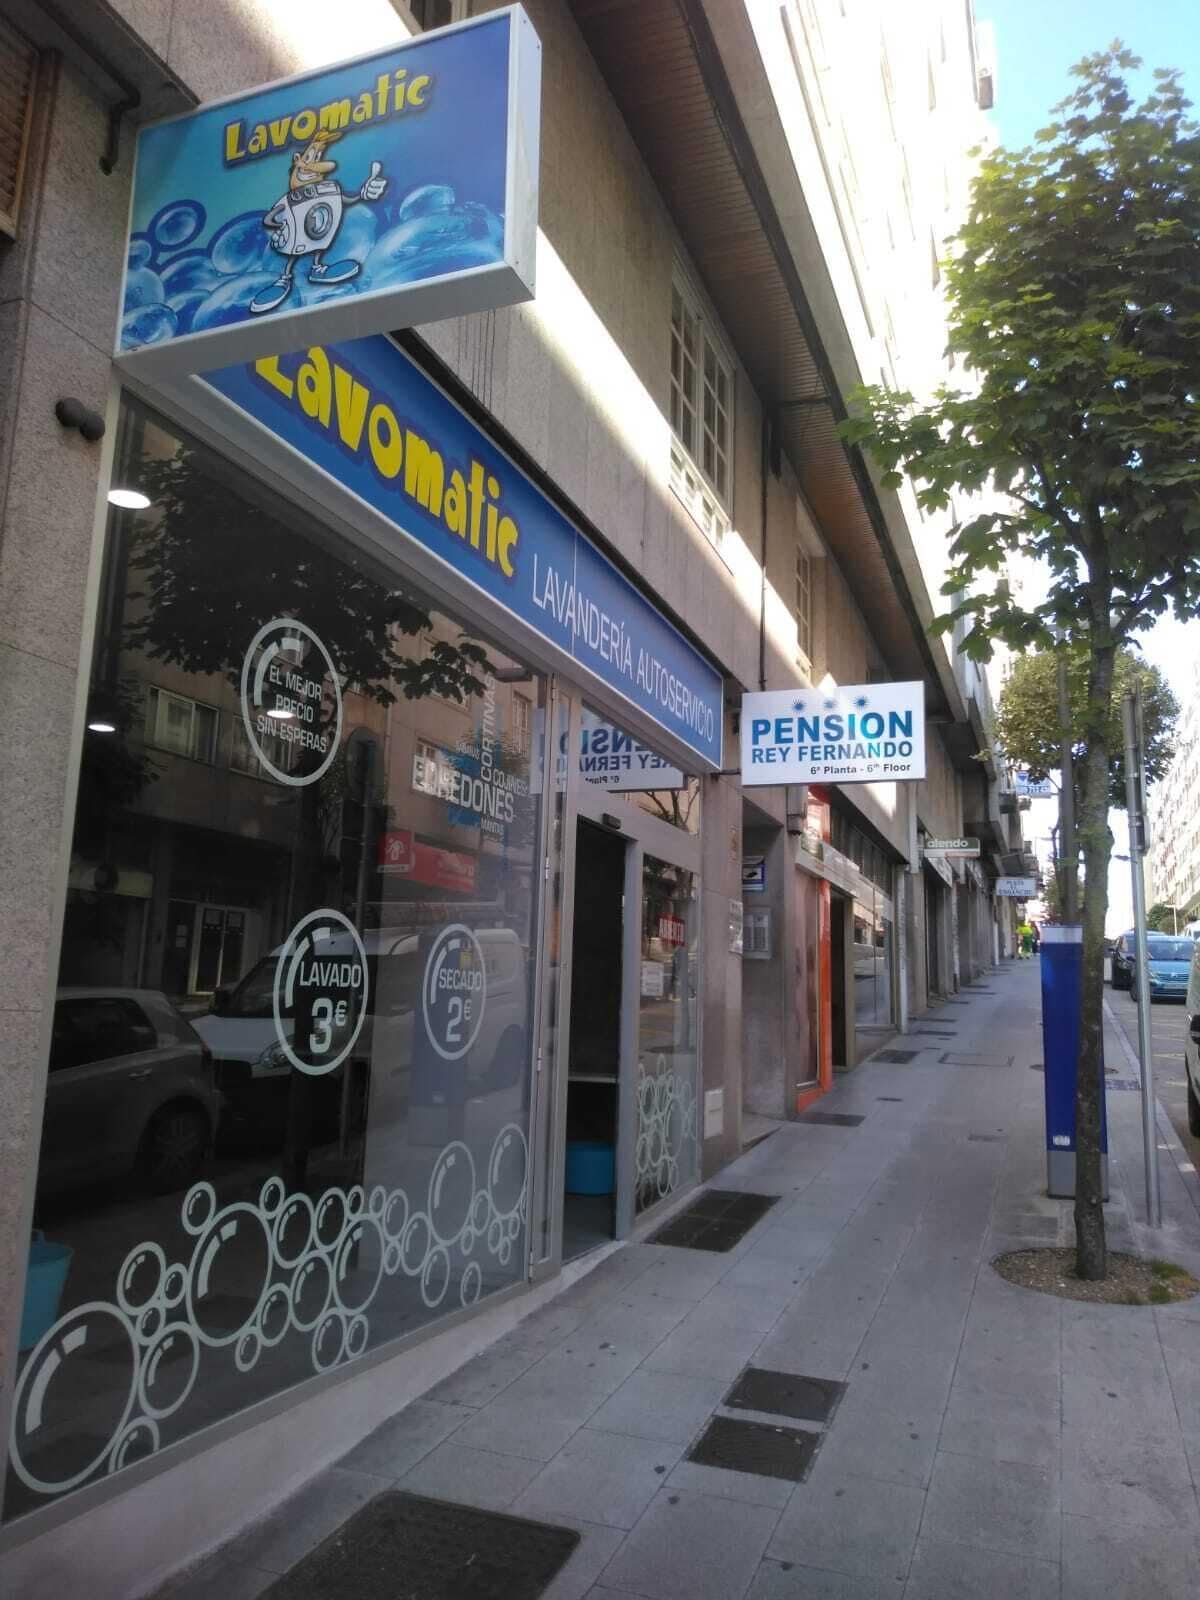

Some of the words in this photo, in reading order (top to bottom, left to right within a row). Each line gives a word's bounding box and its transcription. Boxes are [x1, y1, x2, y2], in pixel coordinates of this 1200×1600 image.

[226, 69, 432, 161] Lavomatic
[533, 553, 634, 681] LAVANDERÍA
[637, 648, 714, 744] AUTOSERVICIO
[269, 665, 282, 685] EL
[286, 671, 322, 701] MEJOR
[276, 694, 314, 723] PRECIO
[257, 715, 277, 737] SIN
[280, 723, 328, 753] ESPERAS
[480, 673, 497, 782] CORTINAS
[752, 711, 912, 745] PENSION
[752, 747, 790, 763] REY
[799, 741, 913, 761] FERNANDO
[824, 764, 857, 775] Planta
[883, 763, 911, 773] Floor
[300, 961, 362, 988] LAVADO
[439, 968, 483, 991] SECADO
[310, 998, 348, 1054] 3€
[446, 996, 473, 1042] 2€
